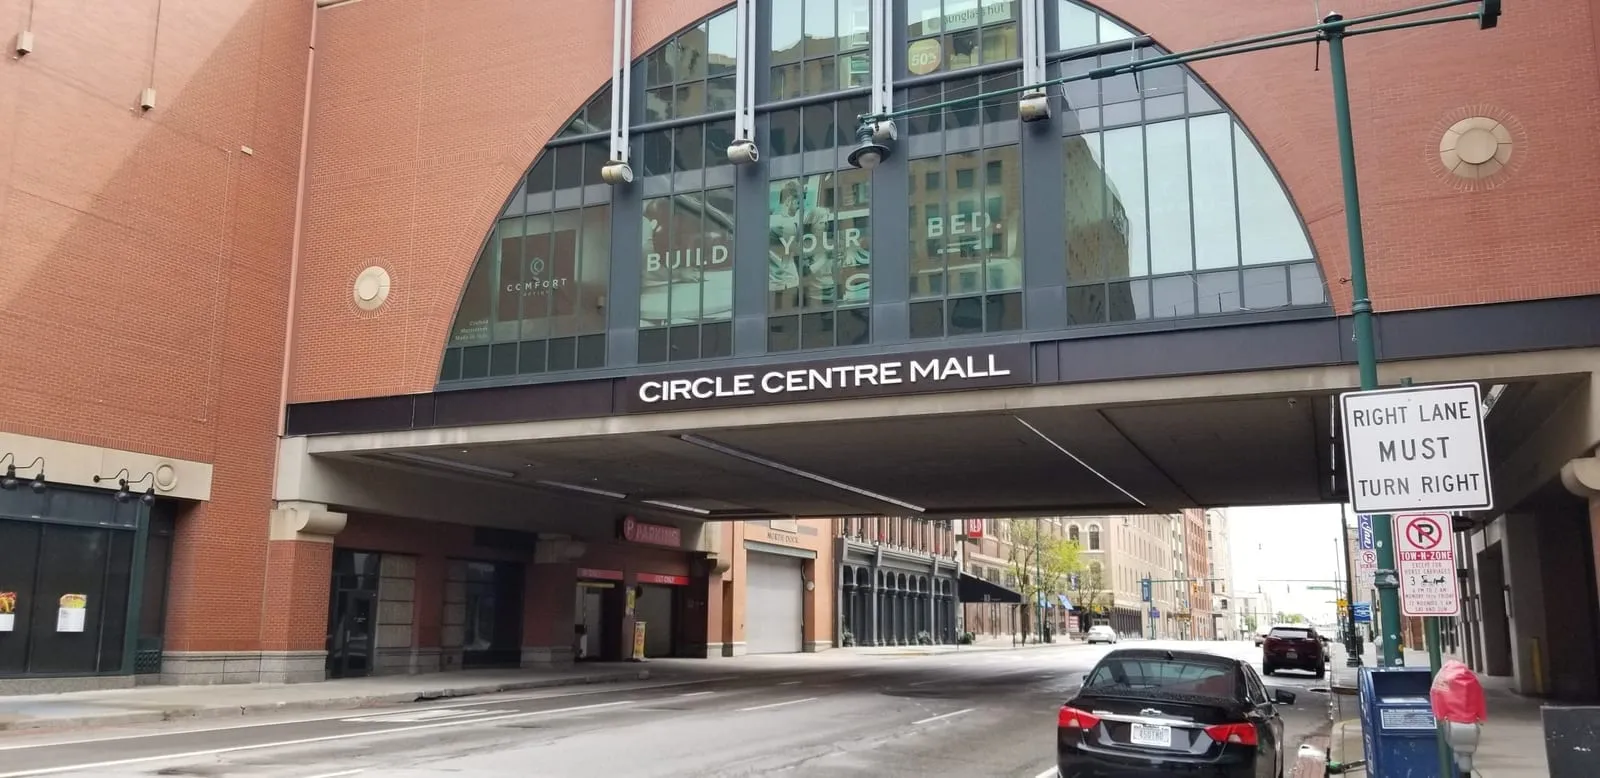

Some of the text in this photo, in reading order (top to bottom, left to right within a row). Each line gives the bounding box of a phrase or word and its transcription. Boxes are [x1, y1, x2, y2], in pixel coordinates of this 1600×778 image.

[779, 228, 861, 255] YOUR
[646, 245, 729, 272] BUILD
[639, 354, 1010, 403] CIRCLE CENTRE MALL
[1353, 401, 1471, 427] RIGHT LANE
[1378, 437, 1450, 463] MUST
[1358, 473, 1480, 497] TURN RIGHT
[636, 524, 678, 543] PARKING
[1400, 551, 1453, 560] TOW-N-ZONE
[1410, 575, 1416, 586] 3
